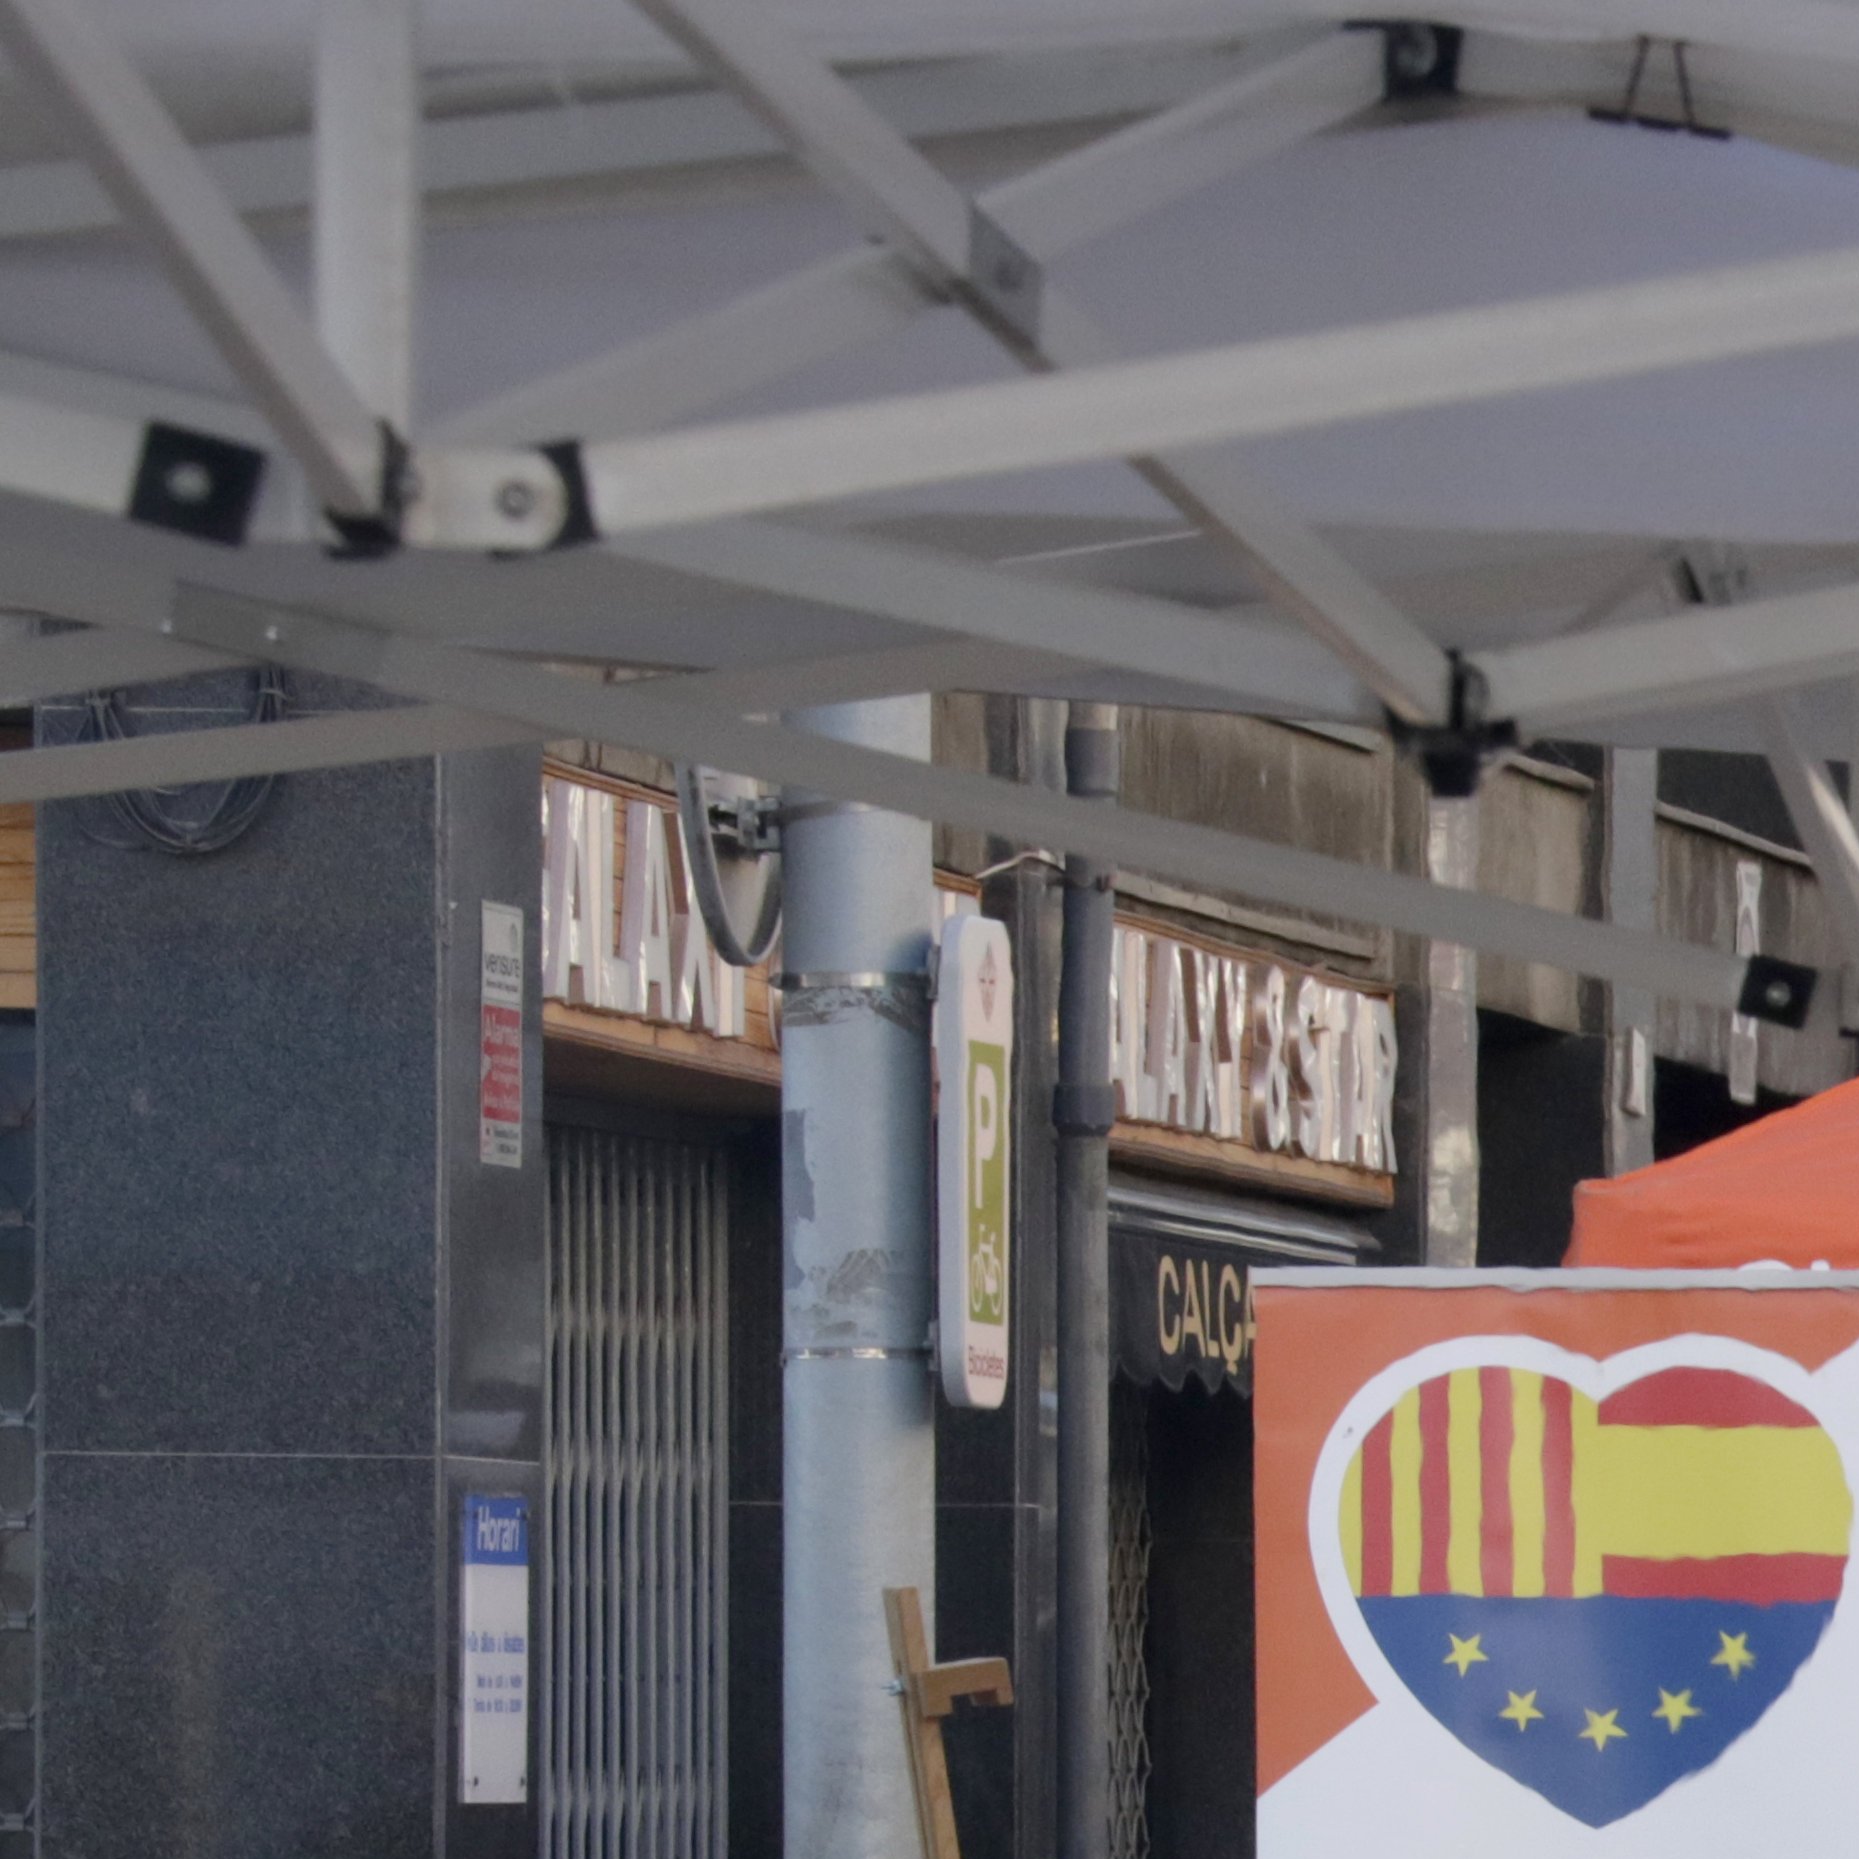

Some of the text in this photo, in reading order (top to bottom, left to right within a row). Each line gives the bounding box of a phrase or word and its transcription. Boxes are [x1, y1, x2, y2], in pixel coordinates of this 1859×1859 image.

[973, 1063, 997, 1210] P
[1258, 964, 1291, 1154] &
[1296, 974, 1398, 1174] STAR
[477, 1506, 521, 1552] Horari
